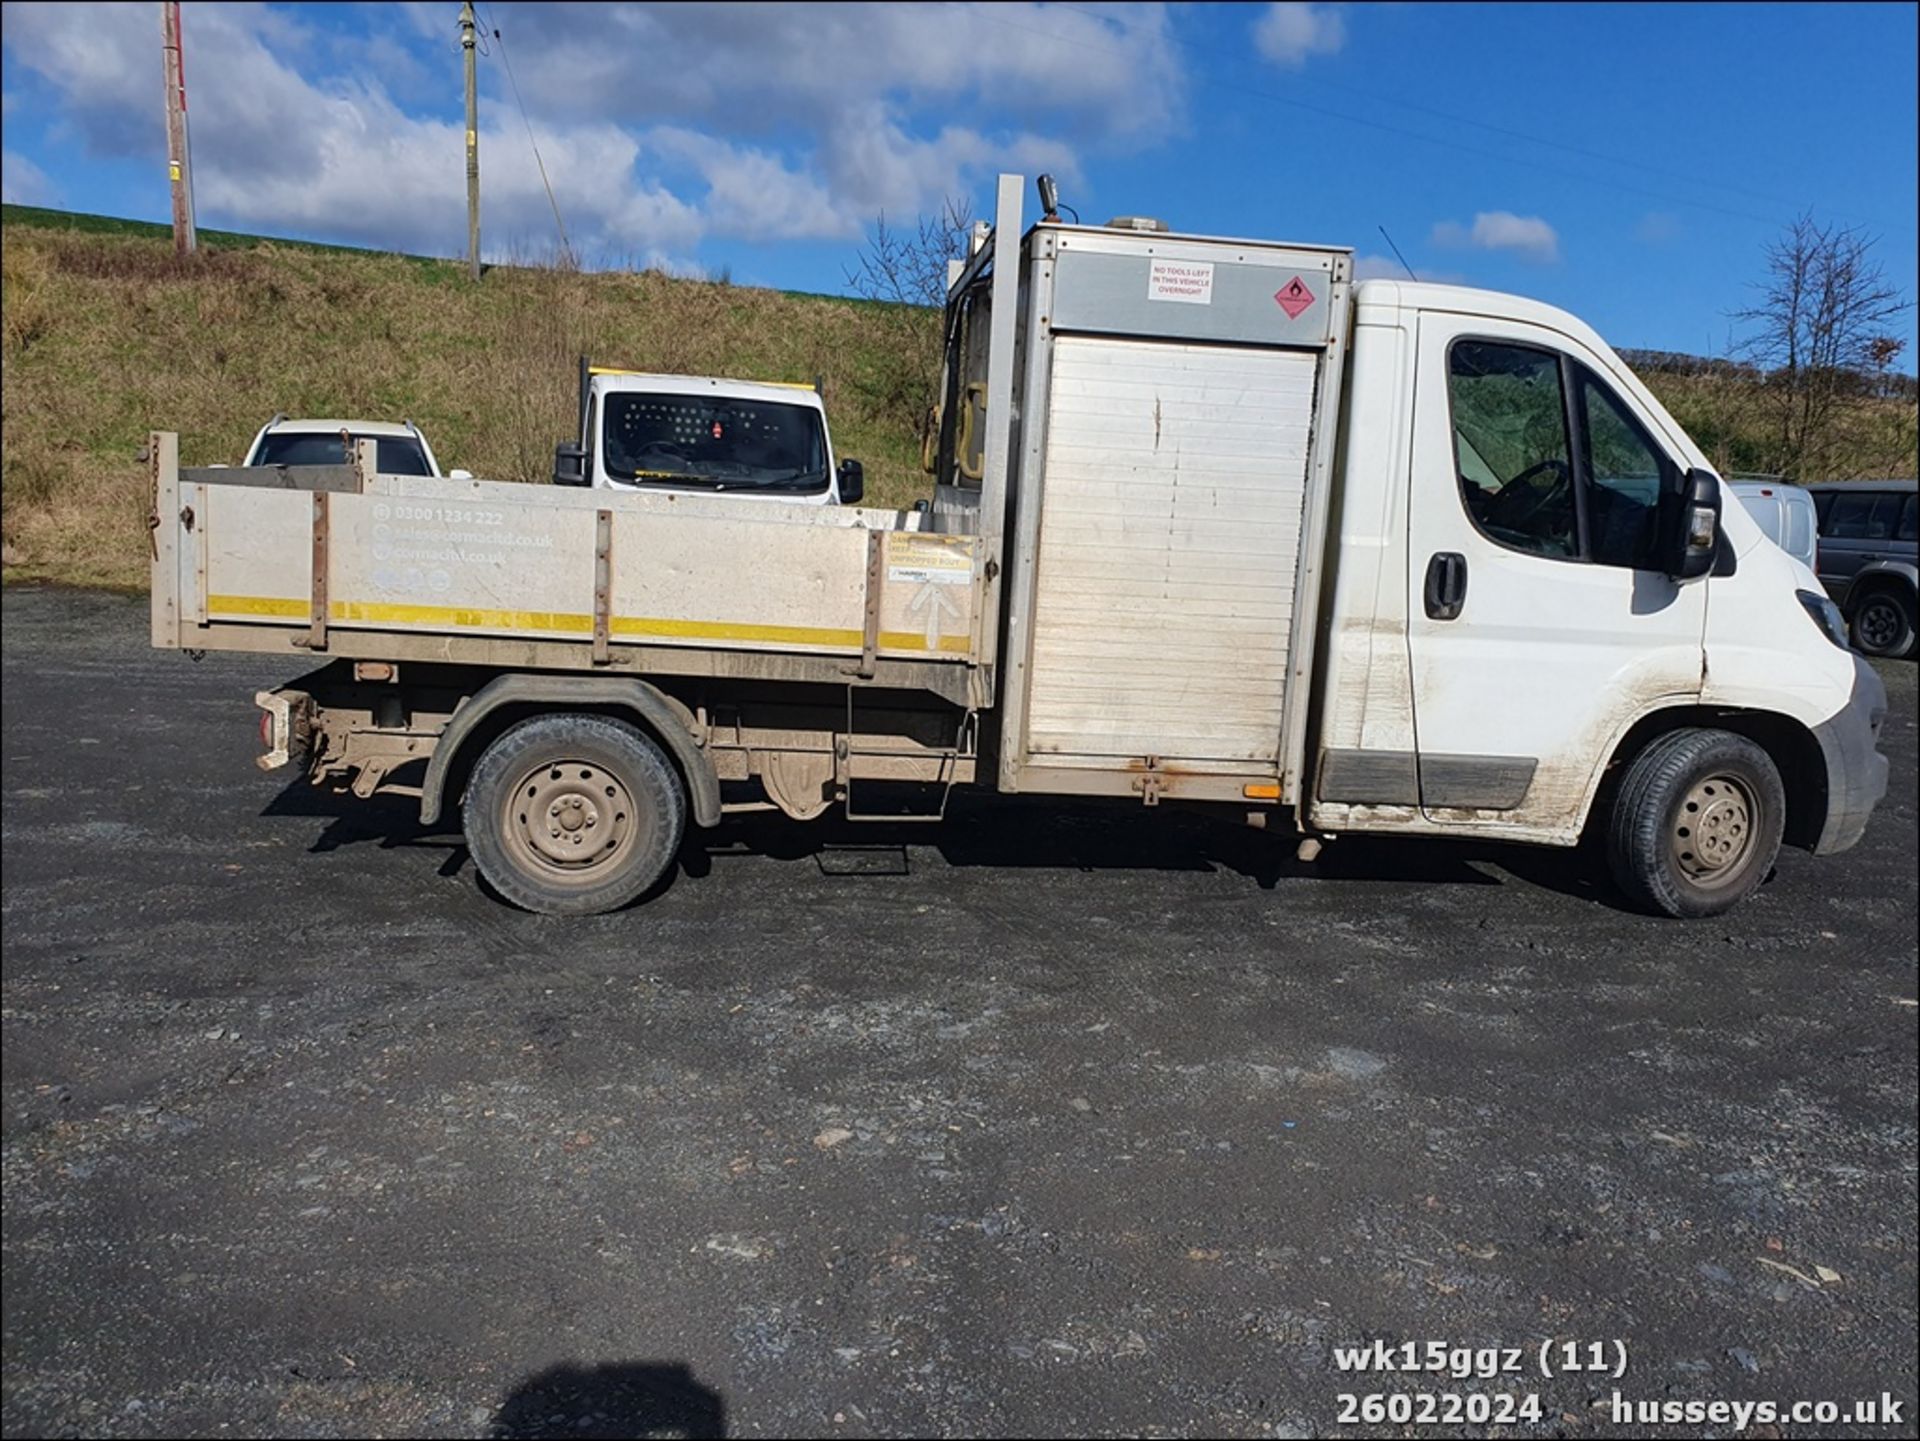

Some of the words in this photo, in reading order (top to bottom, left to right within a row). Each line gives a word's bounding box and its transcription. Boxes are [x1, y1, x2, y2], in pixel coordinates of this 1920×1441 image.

[1154, 266, 1166, 274] NO
[1167, 267, 1191, 276] TOOLS
[1192, 269, 1210, 277] LEFT
[1161, 276, 1178, 285] THIS
[1179, 279, 1210, 287] VEHICLE
[1158, 286, 1202, 296] OVERNIGHT
[396, 506, 433, 521] 0300
[436, 508, 472, 523] 1234
[475, 511, 504, 525] 222
